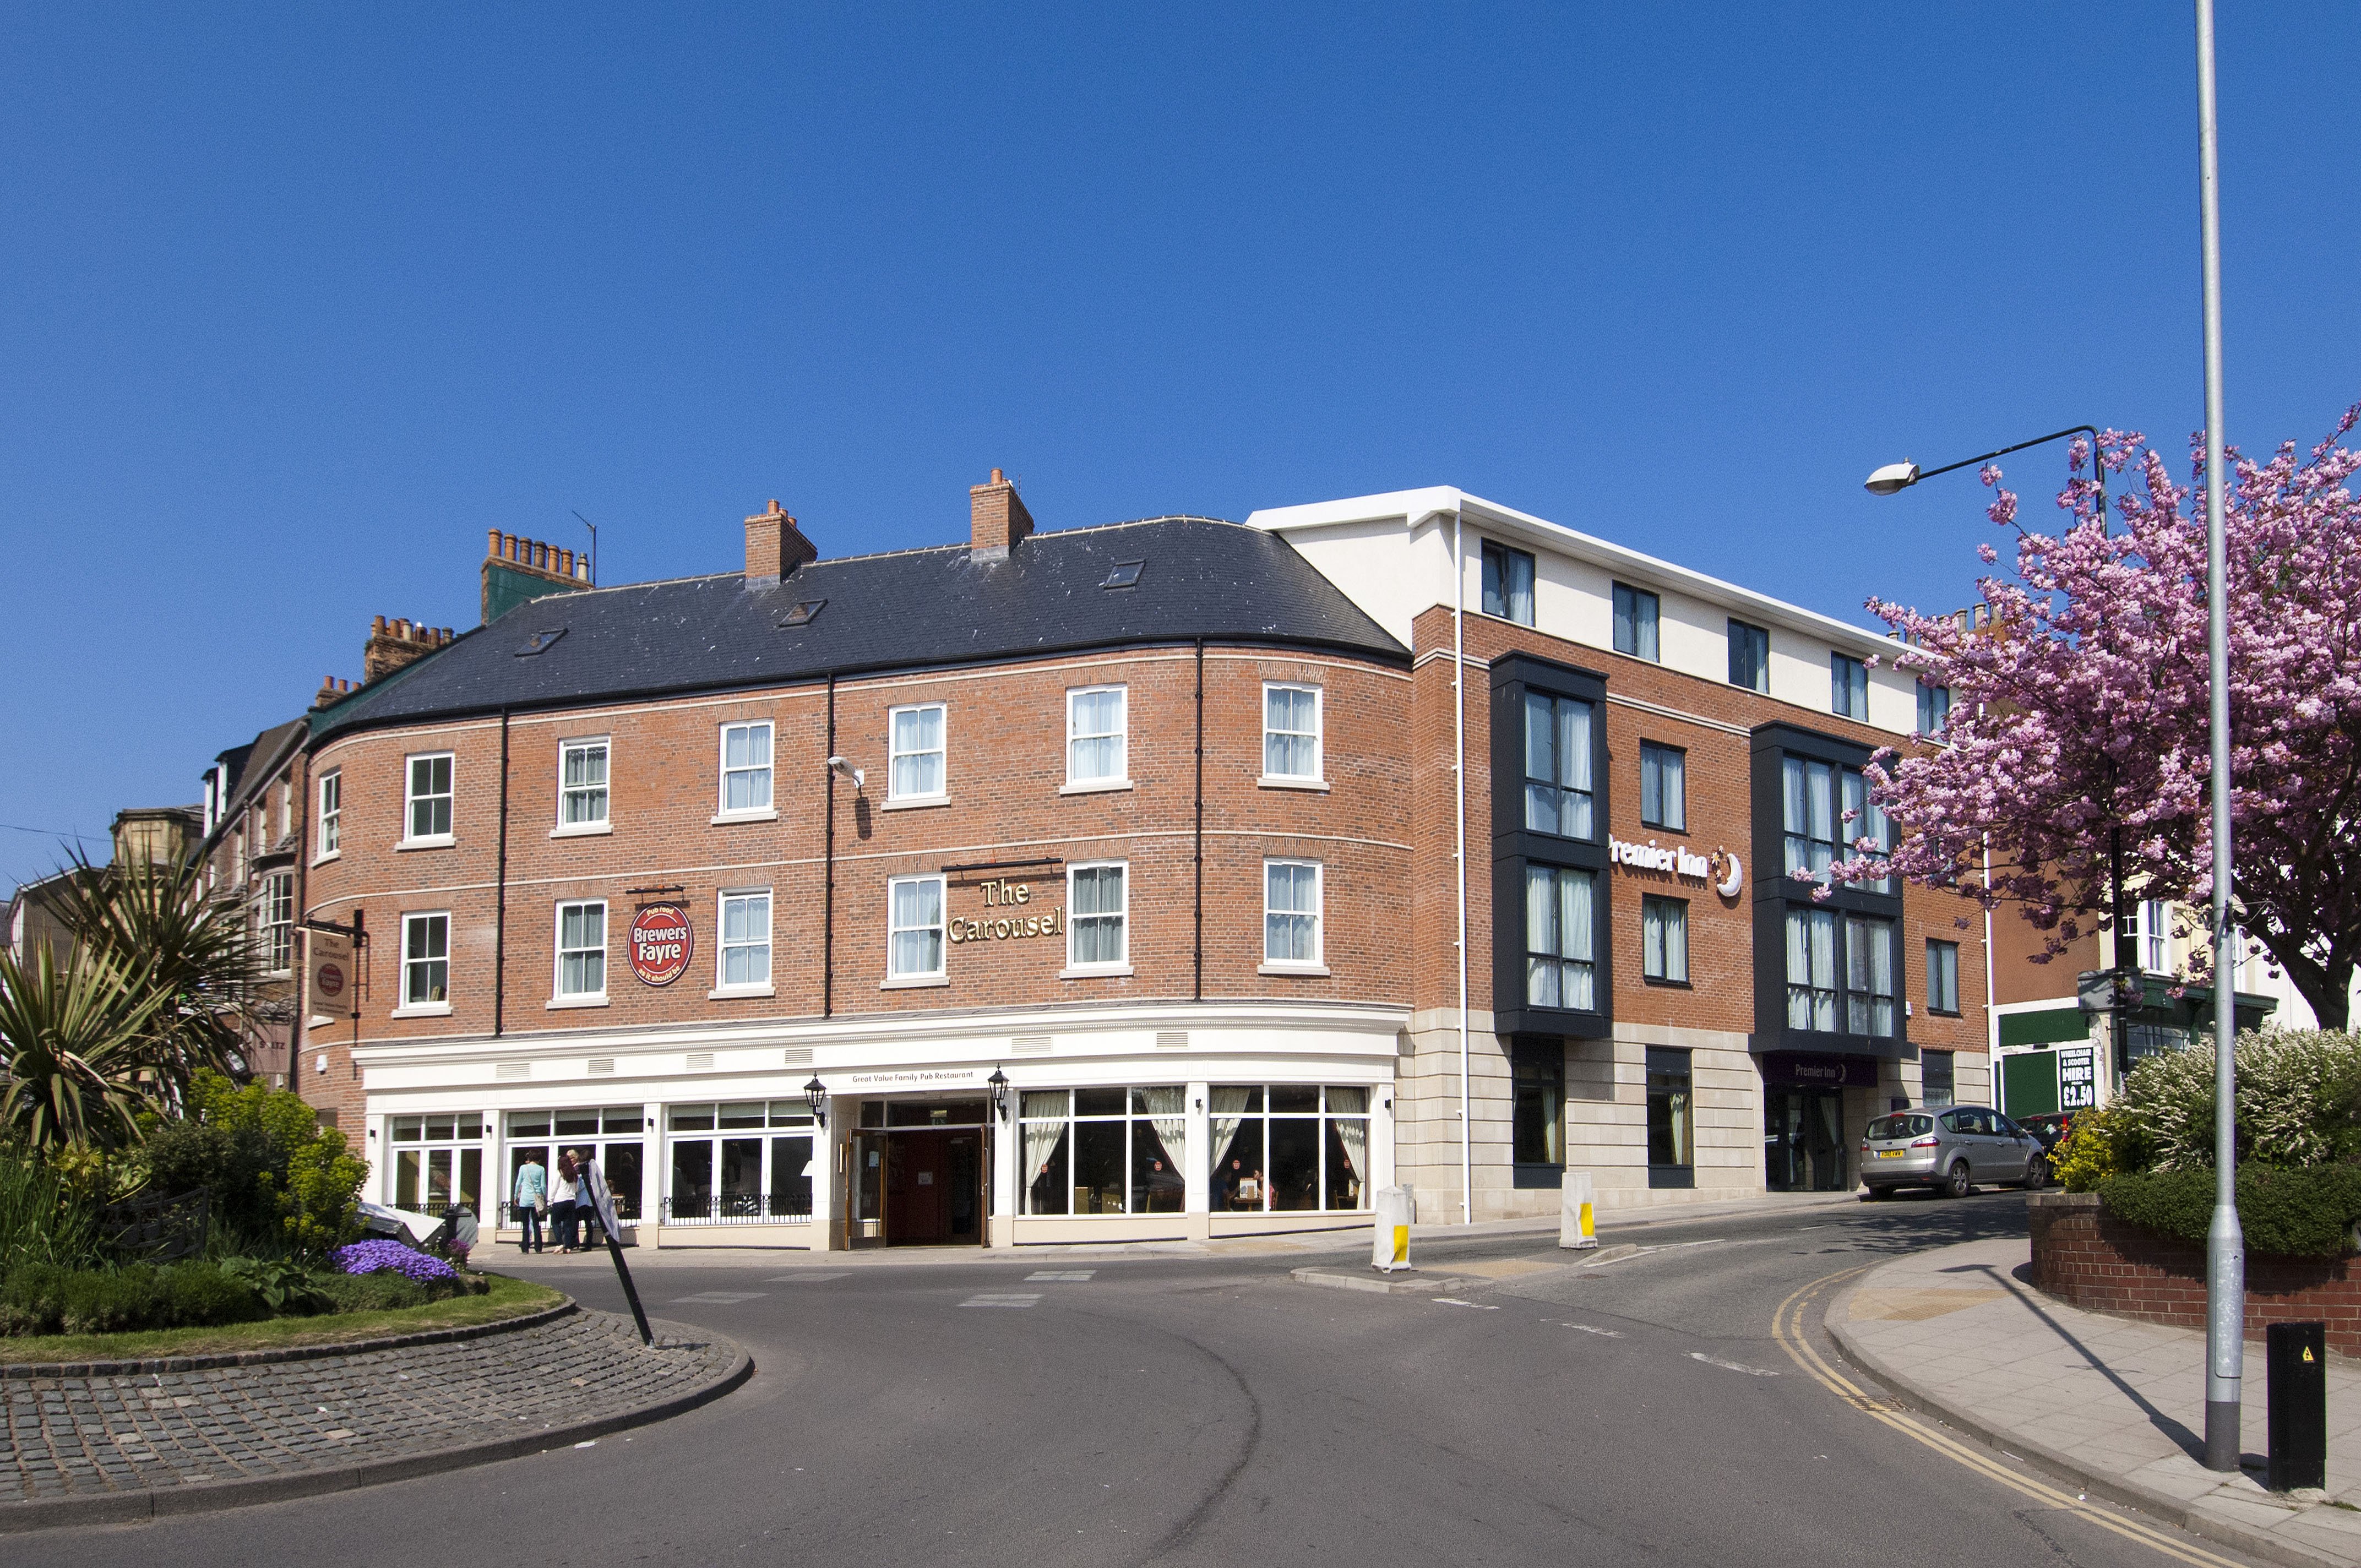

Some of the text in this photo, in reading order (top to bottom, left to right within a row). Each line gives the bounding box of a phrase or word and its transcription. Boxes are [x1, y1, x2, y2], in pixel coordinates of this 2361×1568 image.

[1678, 846, 1708, 878] Inn
[980, 878, 1030, 907] The
[948, 906, 1063, 944] Carousel
[634, 927, 687, 943] Brewers
[324, 938, 339, 948] The
[313, 948, 349, 961] Carousel
[639, 943, 681, 965] Fayre
[651, 971, 672, 982] should
[672, 966, 680, 974] be
[2060, 1048, 2091, 1058] WHEELCHAIR
[2068, 1057, 2090, 1066] SCOOTER
[895, 1073, 918, 1082] Family
[1796, 1064, 1835, 1078] Premier Inn
[2062, 1066, 2092, 1081] HIRE
[2063, 1085, 2092, 1107] £2.50
